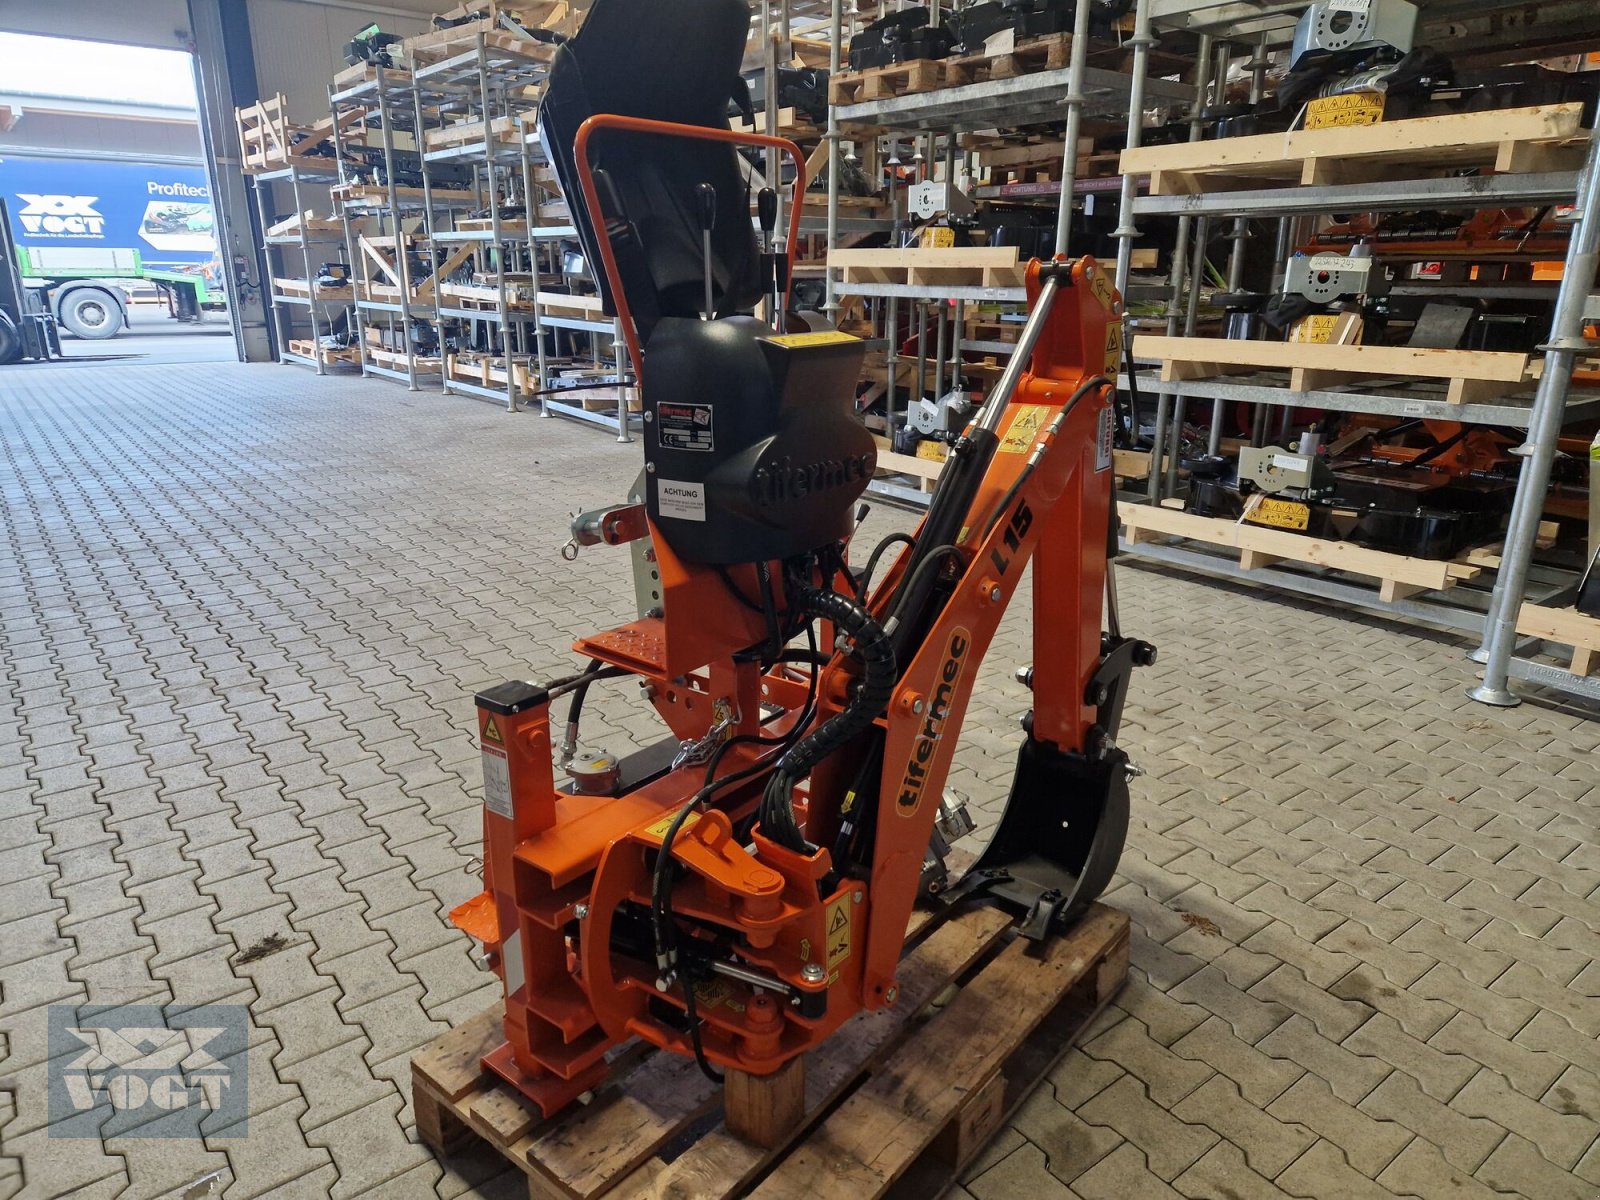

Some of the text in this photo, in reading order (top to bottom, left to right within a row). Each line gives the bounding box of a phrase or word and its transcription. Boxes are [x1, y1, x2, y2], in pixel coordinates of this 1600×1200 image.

[19, 214, 105, 234] VOGT
[664, 487, 698, 498] ACHTUNG
[1003, 497, 1034, 554] 15
[898, 635, 966, 807] tifermec
